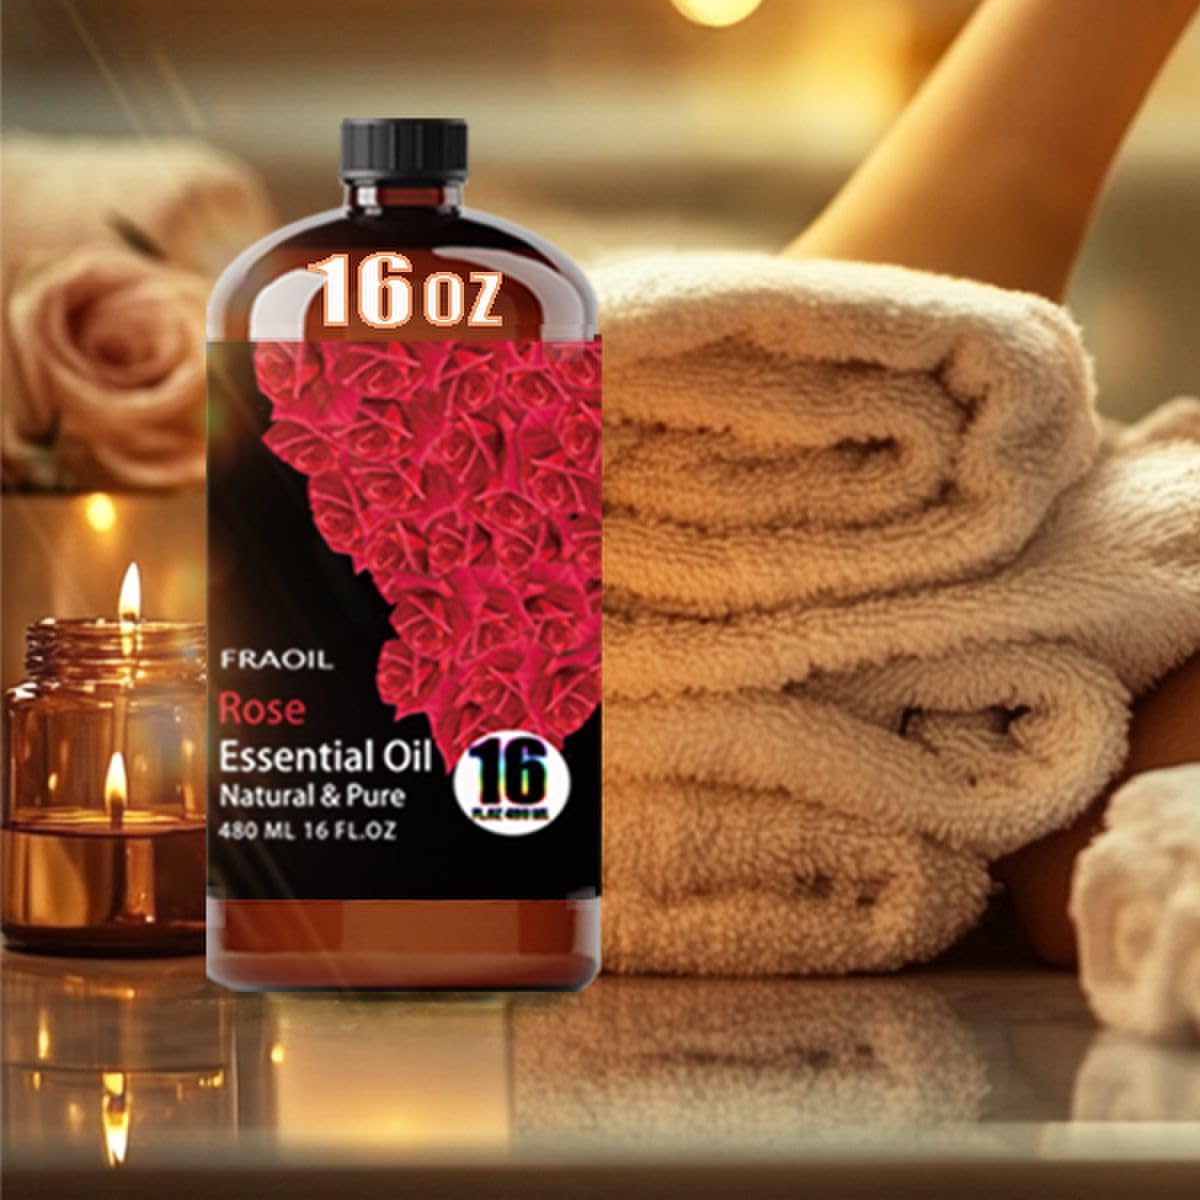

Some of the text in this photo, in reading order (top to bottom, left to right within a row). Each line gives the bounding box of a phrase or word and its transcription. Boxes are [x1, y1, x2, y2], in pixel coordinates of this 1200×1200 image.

[307, 251, 414, 329] 16
[220, 648, 334, 670] FRAOIL
[218, 690, 306, 726] Rose
[219, 738, 432, 773] Essential Oil
[468, 736, 548, 806] 16
[219, 782, 406, 808] Natural & Pure
[218, 820, 397, 841] 480 ML 16 FL.OZ
